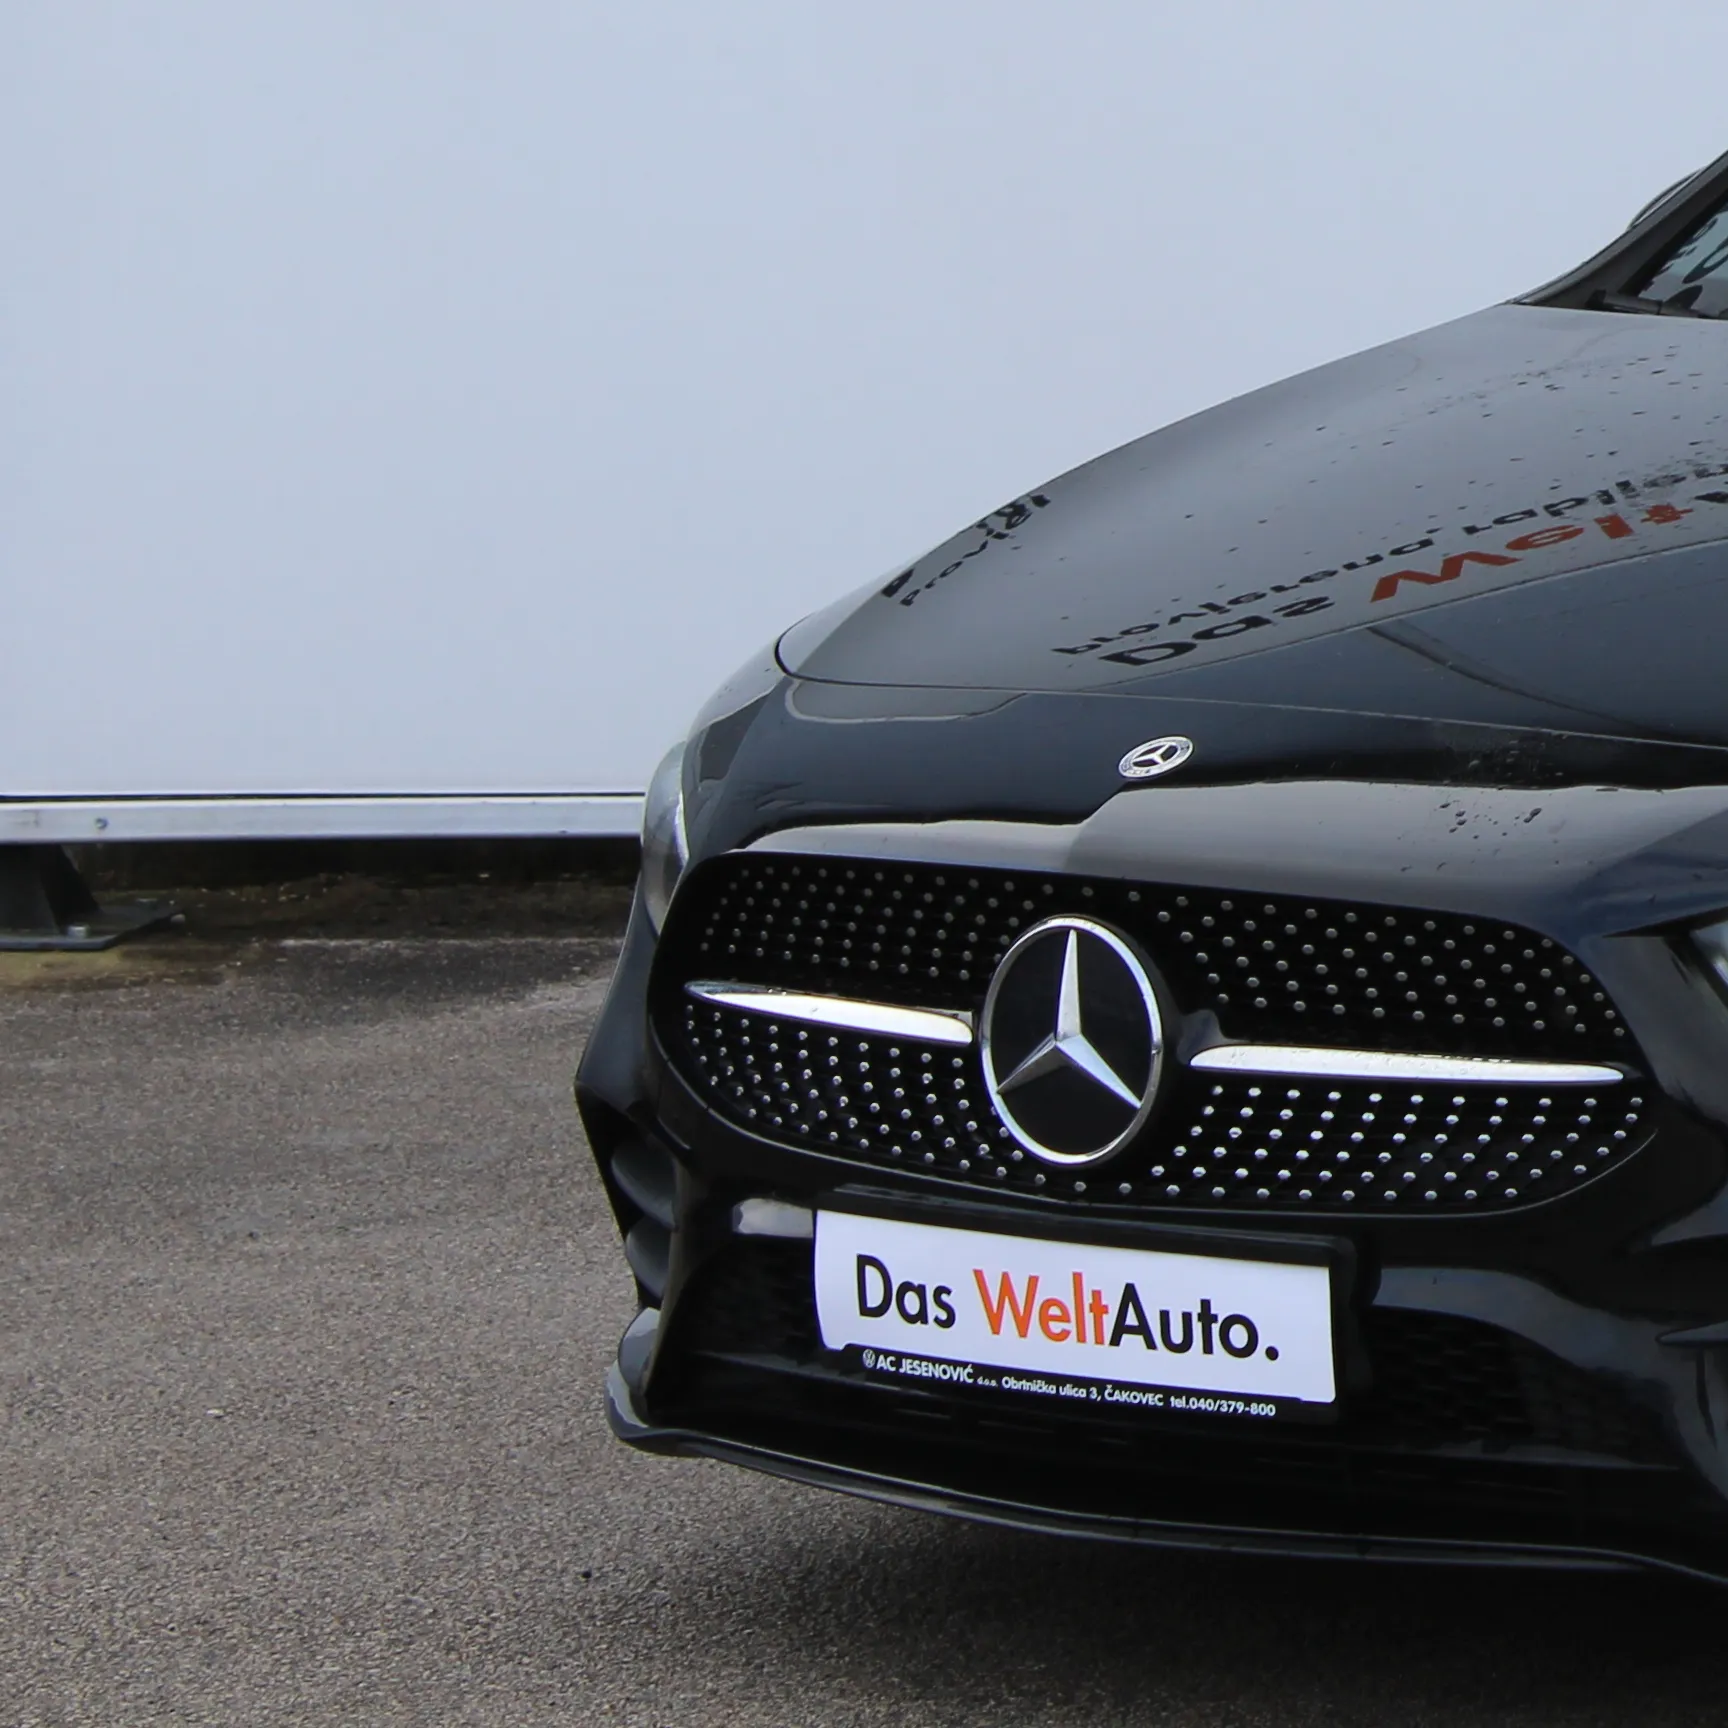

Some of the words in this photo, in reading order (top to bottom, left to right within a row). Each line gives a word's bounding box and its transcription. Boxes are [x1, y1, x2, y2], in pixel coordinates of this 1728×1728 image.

[857, 1253, 957, 1330] Das
[972, 1269, 1280, 1362] WeltAuto.
[876, 1355, 897, 1372] AC
[899, 1358, 975, 1384] JESENOVIĆ
[1002, 1376, 1057, 1395] Obrtnička
[1059, 1384, 1087, 1398] ulica
[1089, 1387, 1102, 1402] 3,
[1104, 1385, 1165, 1407] ČAKOVEC
[1170, 1395, 1277, 1417] tel.040/379-800
